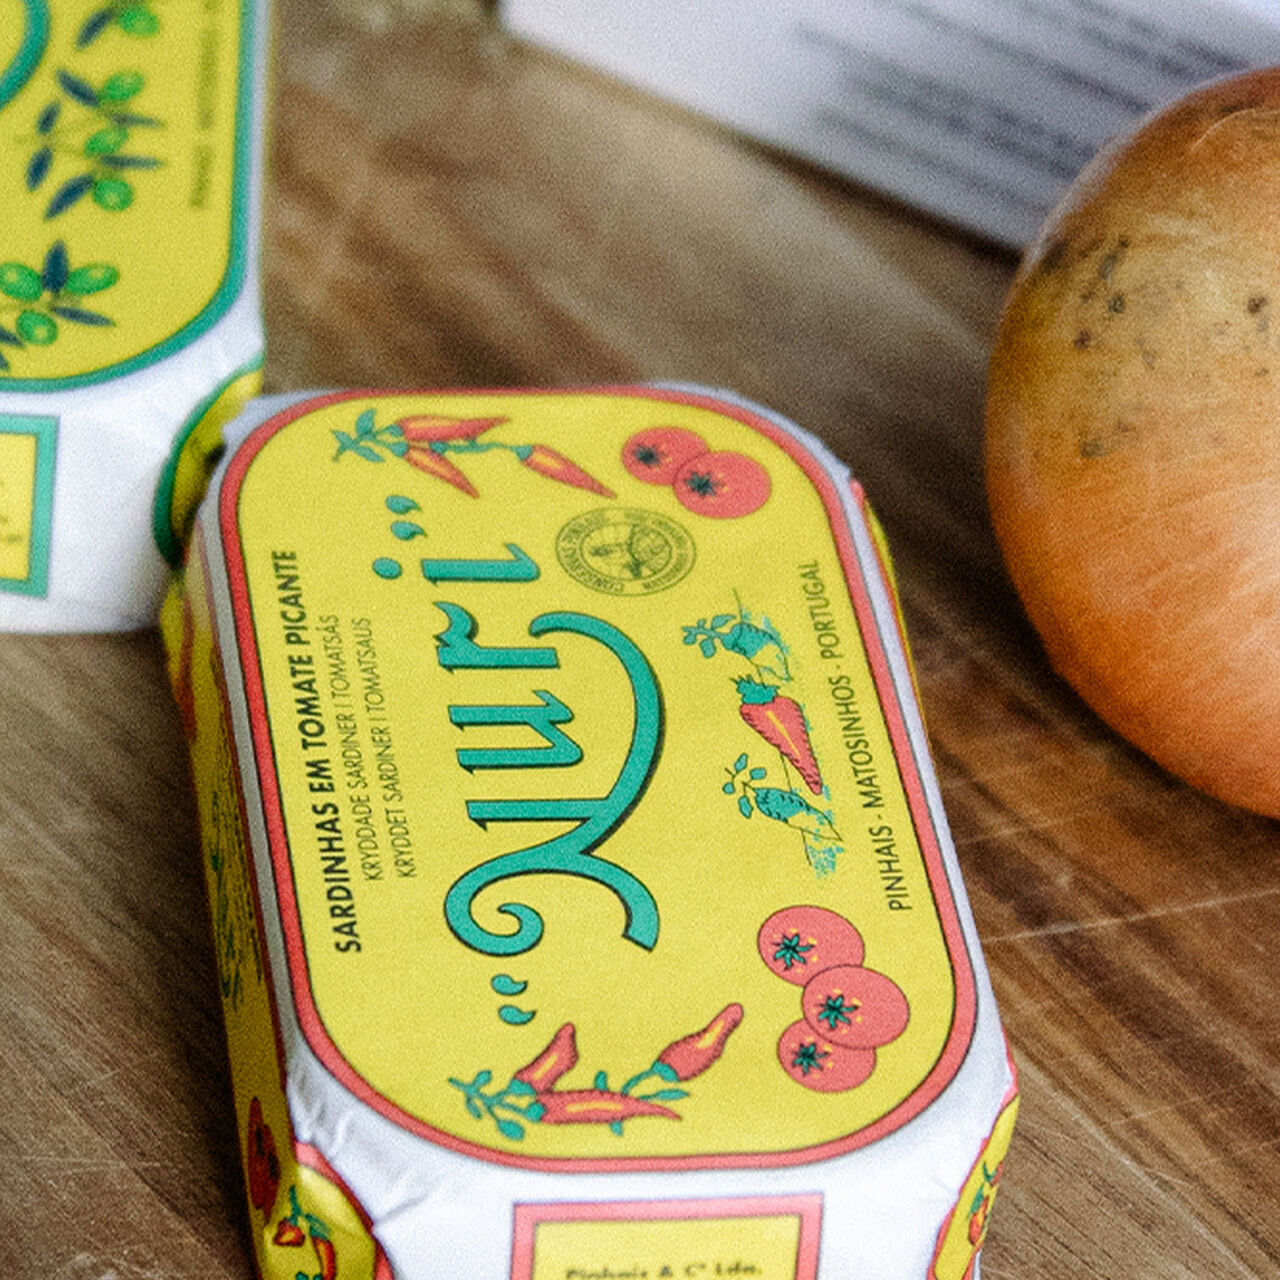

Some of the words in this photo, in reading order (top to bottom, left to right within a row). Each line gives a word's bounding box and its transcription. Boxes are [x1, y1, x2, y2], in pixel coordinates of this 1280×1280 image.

[271, 550, 311, 646] PICANTE
[798, 559, 845, 660] PORTUGAL
[287, 654, 328, 751] TOMATE
[351, 617, 385, 713] TOMATSAUS
[305, 758, 336, 793] EM
[335, 713, 369, 789] SARDINER
[370, 725, 404, 803] SARDINER
[828, 675, 885, 808] MATOSINHOS
[311, 802, 362, 953] SARDINHAS
[350, 794, 384, 882] KRYDDADE
[384, 807, 418, 879] KRYDDET
[868, 825, 913, 911] PINHAIS
